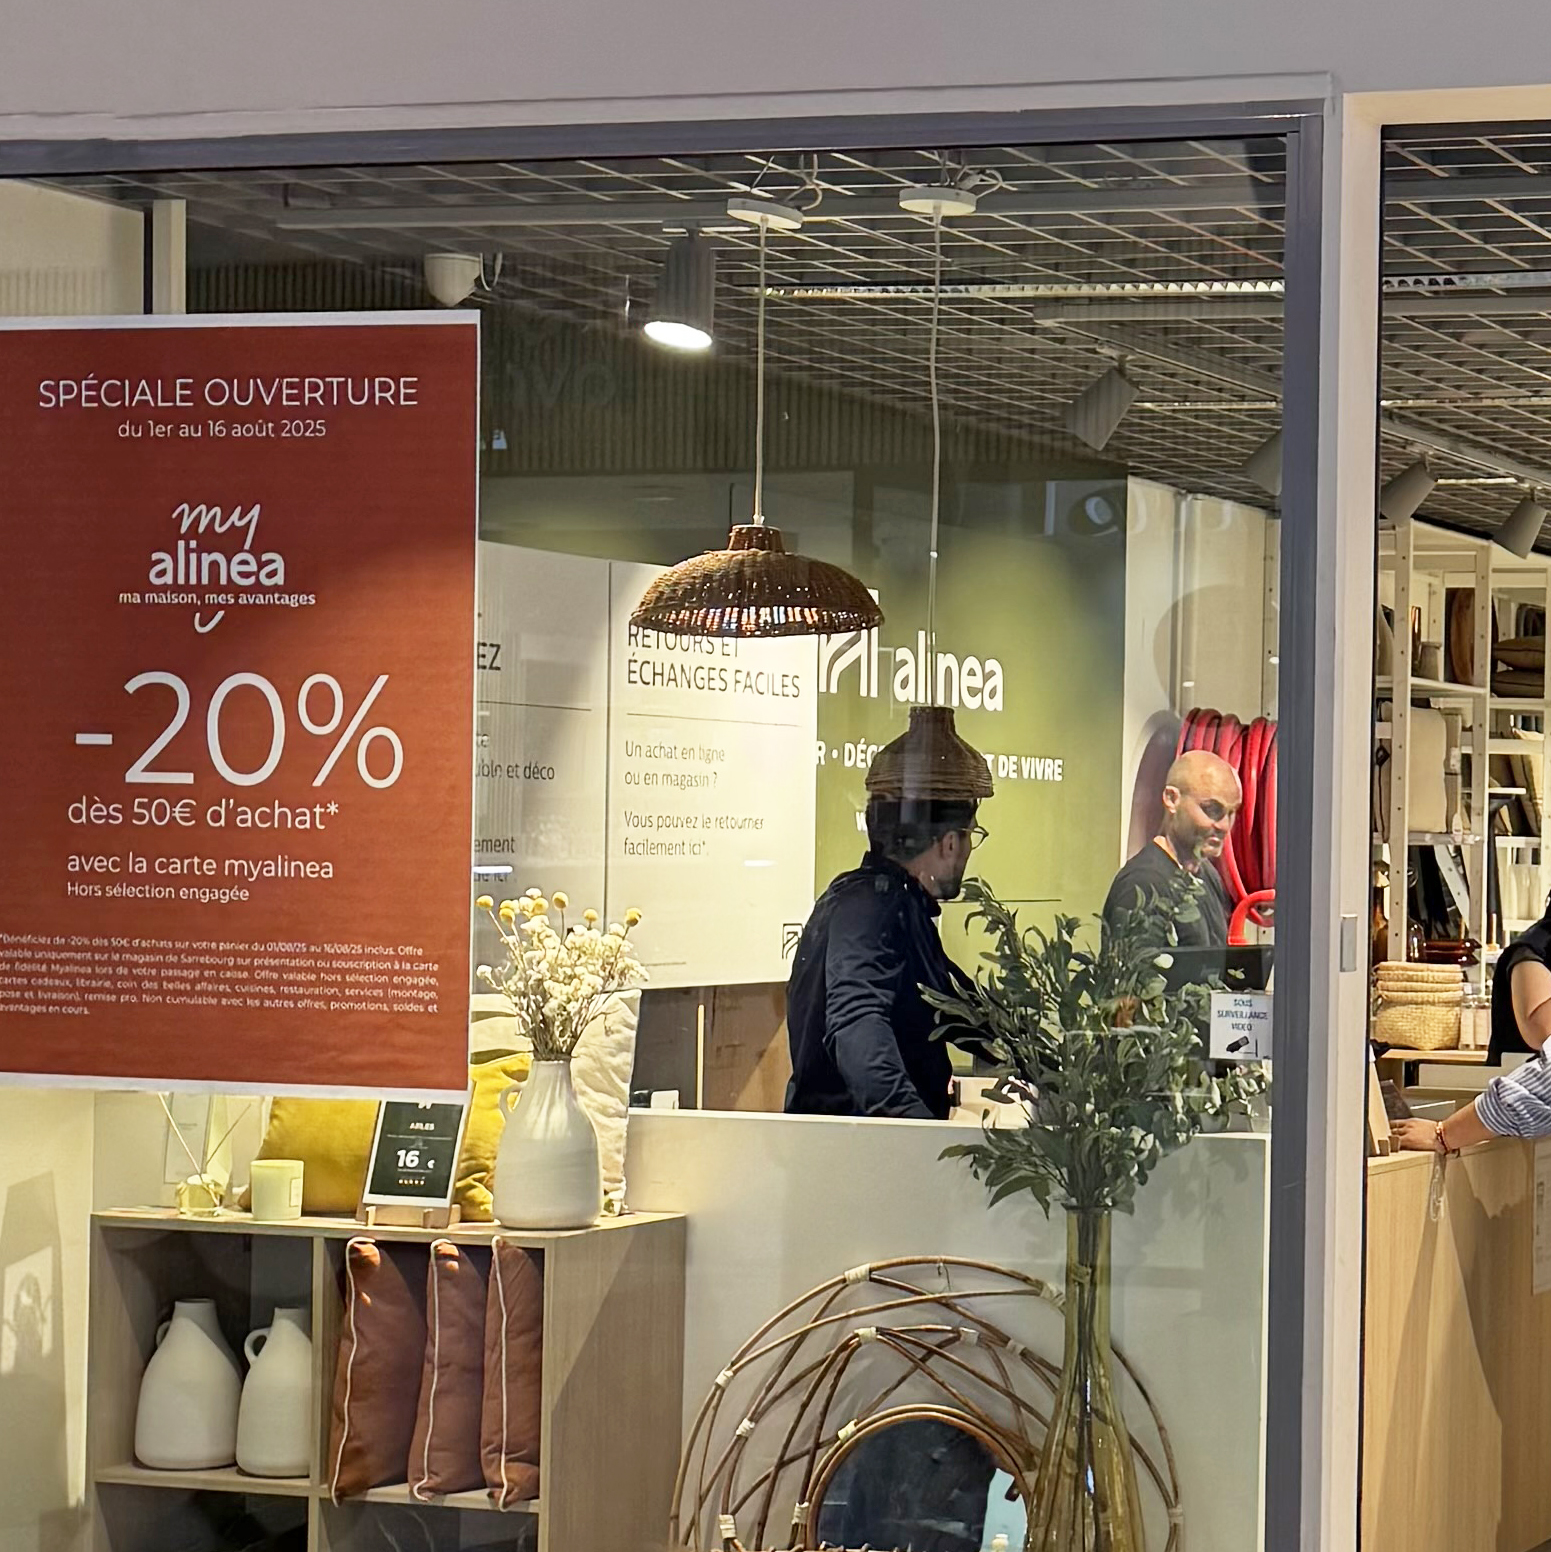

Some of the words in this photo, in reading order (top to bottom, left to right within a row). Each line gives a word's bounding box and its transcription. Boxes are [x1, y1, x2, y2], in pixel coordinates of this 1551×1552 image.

[39, 373, 194, 408] SPÉCIALE
[204, 377, 419, 407] OUVERTURE
[118, 420, 142, 438] du
[148, 421, 173, 438] 1er
[179, 423, 201, 438] au
[208, 421, 226, 438] 16
[231, 419, 274, 438] août
[281, 420, 326, 438] 2025
[172, 503, 260, 550] my
[149, 540, 285, 586] alinea
[119, 593, 141, 605] ma
[145, 592, 200, 608] maison,
[205, 593, 235, 606] mes
[238, 593, 316, 607] avantages
[627, 652, 728, 692] ÉCHANGES
[734, 668, 801, 698] FACILES
[894, 630, 1004, 712] alinea
[75, 671, 404, 789] -20%
[625, 740, 642, 758] Un
[645, 740, 677, 760] achat
[681, 746, 695, 761] en
[507, 762, 520, 779] et
[523, 759, 555, 780] déco
[998, 754, 1017, 778] DE
[1021, 756, 1064, 781] VIVRE
[625, 771, 640, 785] ou
[644, 772, 658, 786] en
[662, 771, 709, 791] magasin
[68, 795, 123, 826] dès
[132, 798, 196, 827] 50€
[624, 810, 653, 828] Vous
[657, 813, 698, 832] pouvez
[702, 813, 711, 829] le
[714, 816, 764, 830] retourner
[624, 837, 685, 856] facilement
[68, 855, 121, 873] avec
[128, 851, 147, 874] la
[155, 855, 217, 876] carte
[224, 855, 333, 882] myalinea
[67, 882, 101, 899] Hors
[105, 882, 175, 900] sélection
[179, 884, 249, 904] engagée
[397, 1149, 420, 1168] 16
